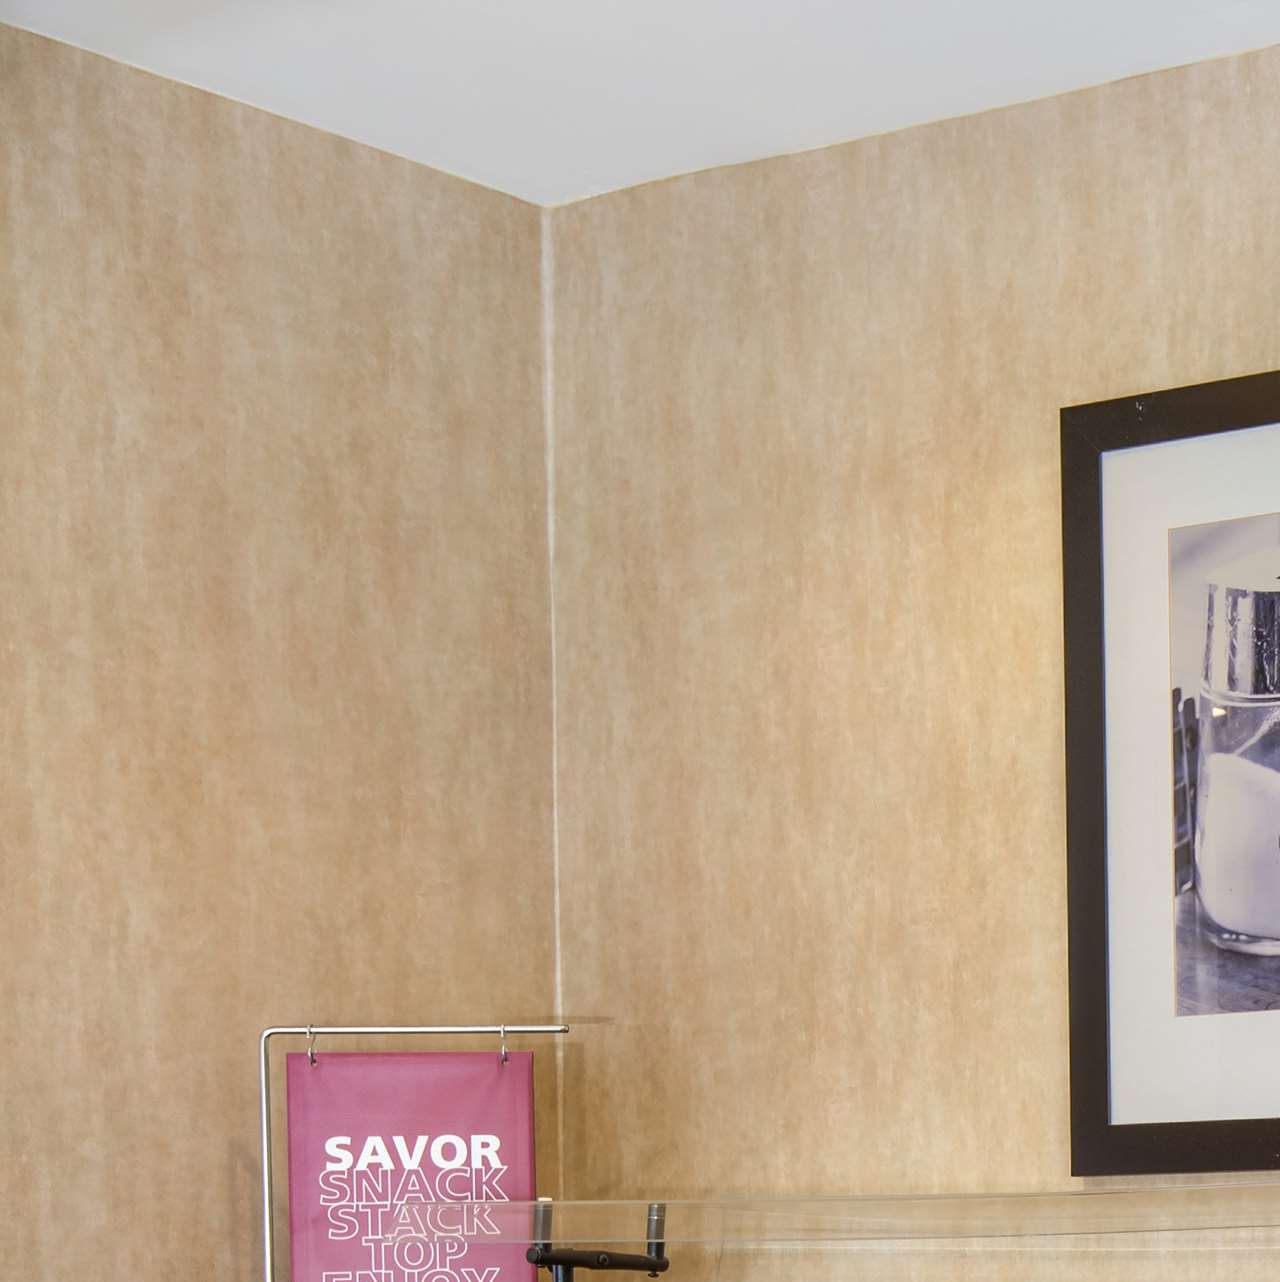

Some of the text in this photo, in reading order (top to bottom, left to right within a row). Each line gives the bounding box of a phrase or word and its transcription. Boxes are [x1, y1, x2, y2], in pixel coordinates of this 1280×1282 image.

[324, 1134, 501, 1170] SAVOR
[319, 1166, 509, 1205] SNACK
[327, 1201, 501, 1239] STACK
[363, 1234, 468, 1272] TOP
